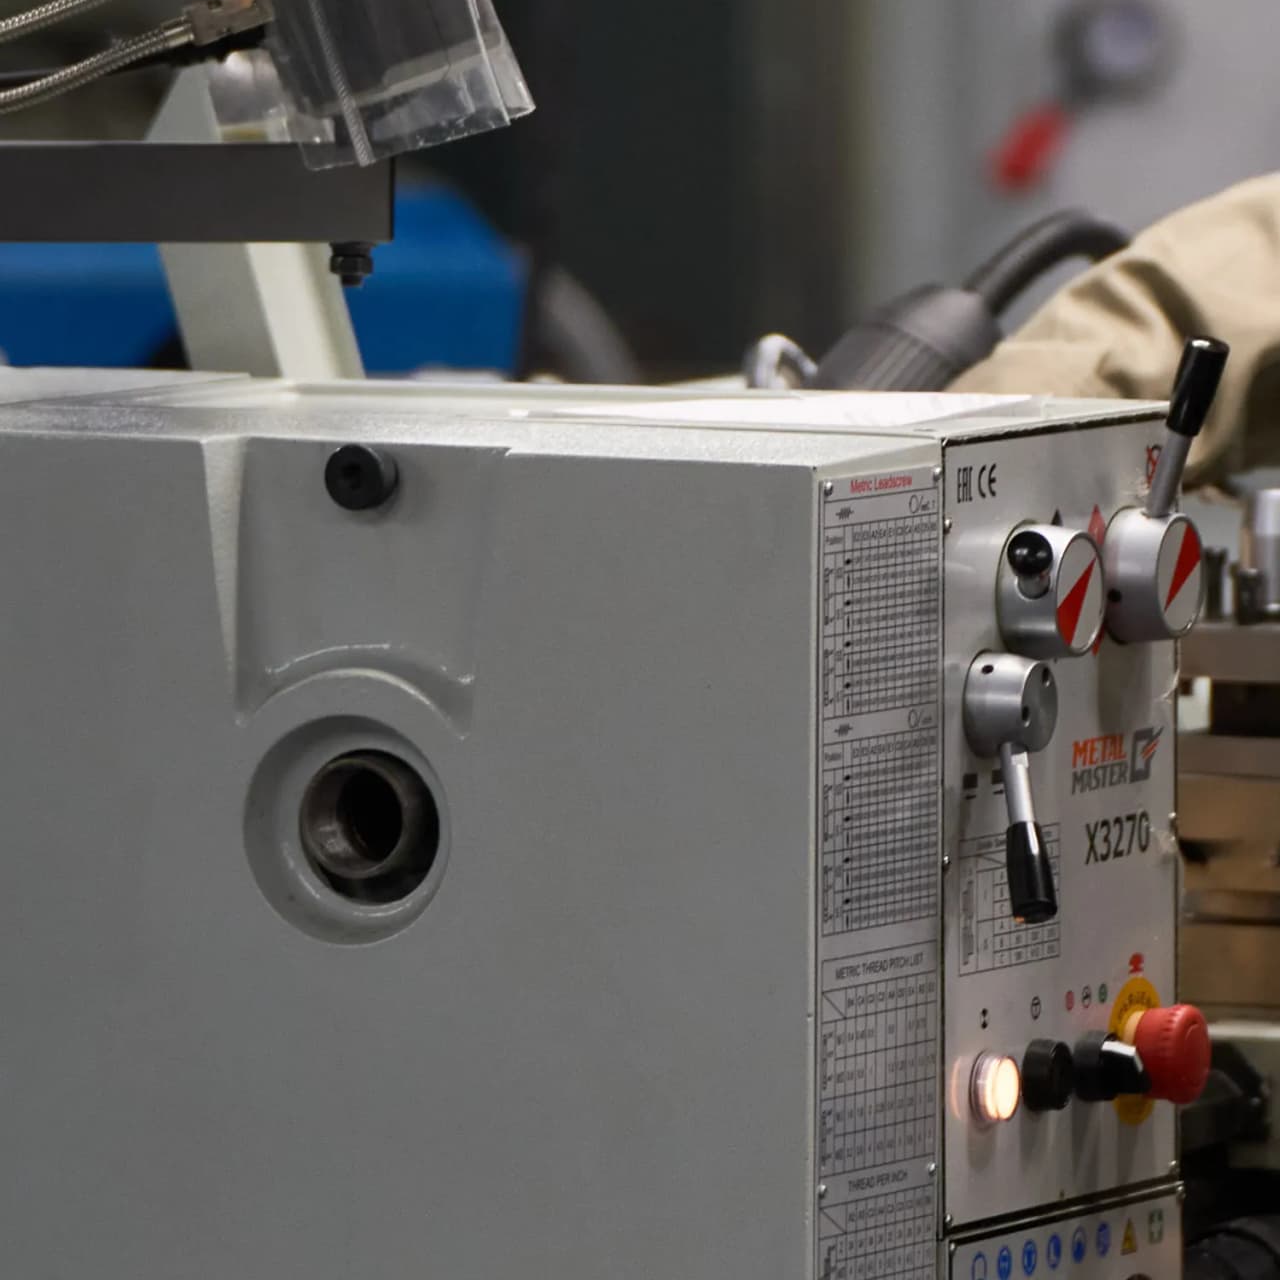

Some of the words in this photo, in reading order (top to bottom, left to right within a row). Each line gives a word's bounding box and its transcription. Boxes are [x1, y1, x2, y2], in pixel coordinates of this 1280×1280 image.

[977, 463, 996, 499] CE
[1072, 734, 1126, 769] METAL
[1071, 761, 1129, 795] MASTER
[1084, 810, 1151, 865] X3270
[835, 964, 860, 980] METRIC
[862, 959, 888, 975] THREAD
[848, 1175, 875, 1192] THREAD
